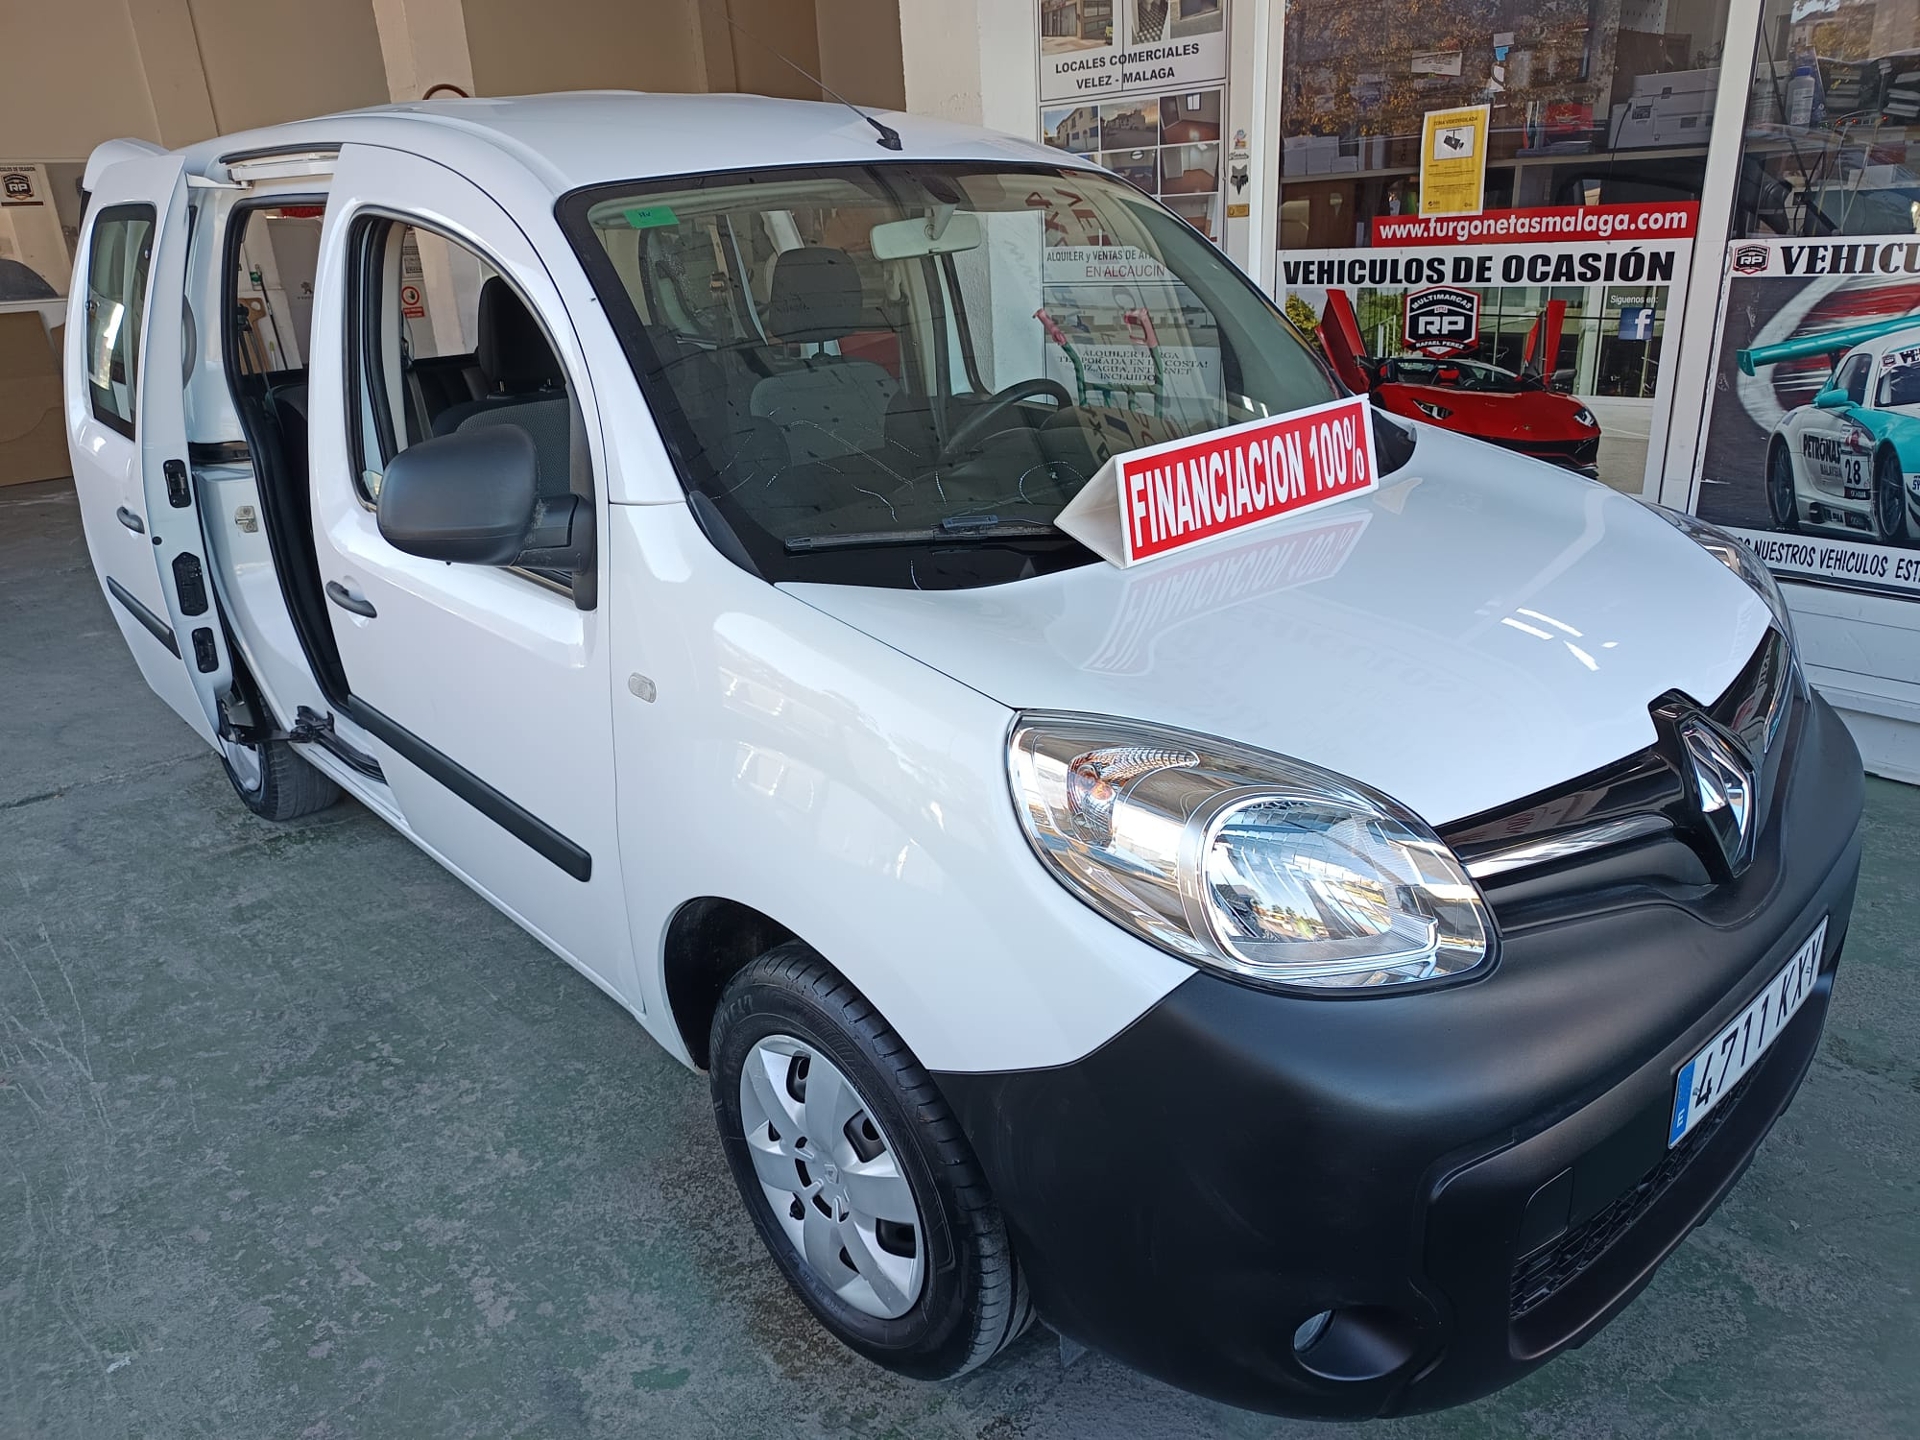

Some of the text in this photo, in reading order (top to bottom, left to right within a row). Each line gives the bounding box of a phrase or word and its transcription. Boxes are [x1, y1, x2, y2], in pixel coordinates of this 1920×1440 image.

[1055, 43, 1200, 74] LOCALES COMERCIALES
[1076, 75, 1112, 89] VELEZ
[1123, 67, 1175, 83] MALAGA
[1379, 208, 1688, 241] www.furgonetasmalaga.com
[1047, 251, 1084, 262] ALQUILER
[1093, 250, 1123, 260] VENTAS
[1125, 250, 1136, 260] DE
[1283, 247, 1675, 285] VEHICULOS DE OCASIÓN
[1740, 256, 1763, 265] RP
[1086, 265, 1165, 277] EN ALCAUCIN
[1411, 293, 1472, 309] MULTIMARCAS
[1418, 316, 1465, 334] RP
[1083, 349, 1138, 359] ALQUILER
[1415, 340, 1465, 349] RAFAEL PEREZ
[1803, 434, 1841, 464] PETRONAS
[1130, 415, 1365, 547] FINANCIACION 100%
[1845, 459, 1861, 485] 28
[1754, 539, 1920, 583] NUESTROS VEHICULOS EST
[1695, 930, 1822, 1109] 4711 KXY
